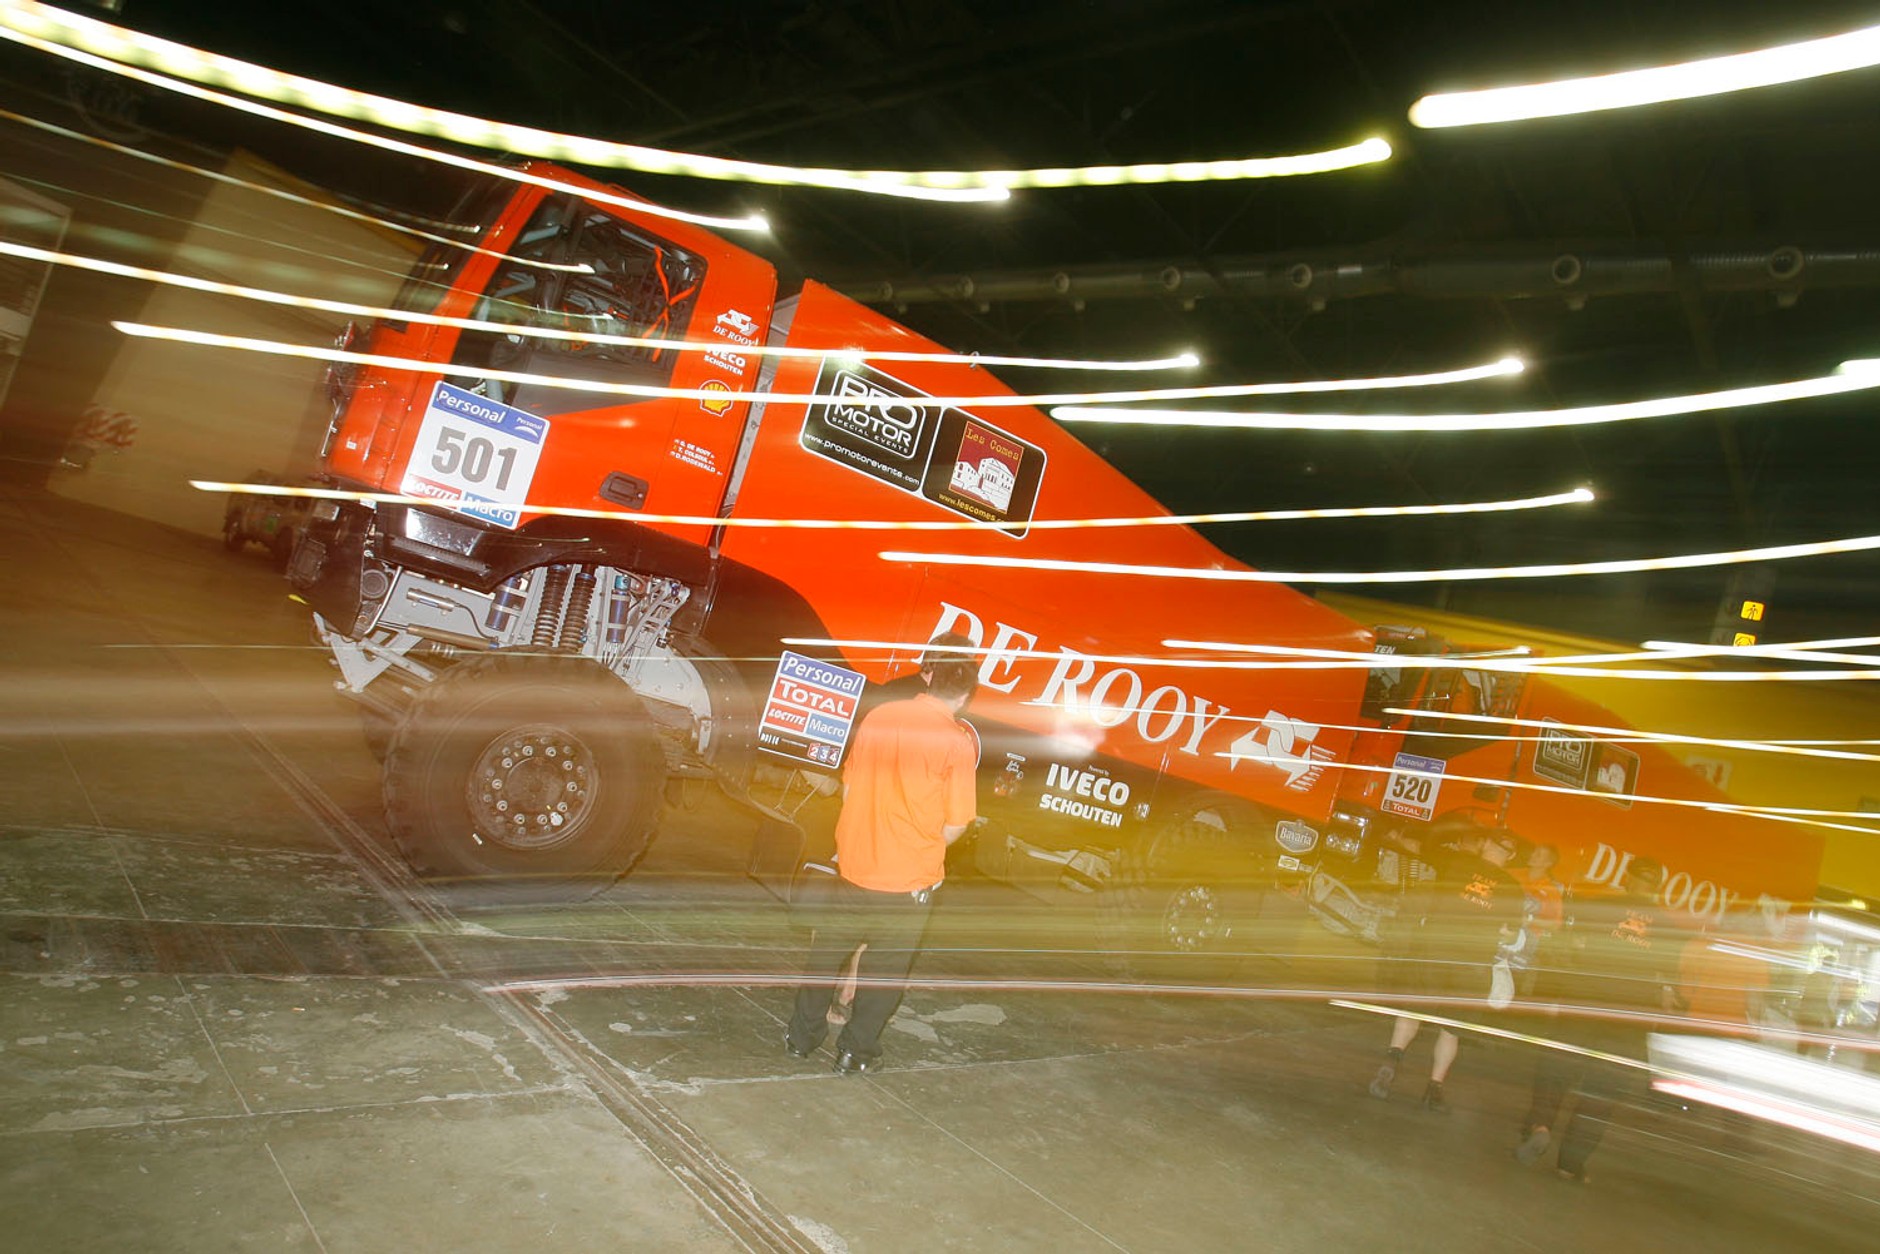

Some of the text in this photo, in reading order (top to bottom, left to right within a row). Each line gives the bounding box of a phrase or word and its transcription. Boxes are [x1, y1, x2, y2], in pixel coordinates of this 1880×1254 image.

[713, 325, 756, 347] DE ROOY
[703, 355, 744, 376] SCHOUTEN
[706, 346, 746, 368] VECO
[436, 389, 543, 430] Personal Personal
[840, 376, 918, 430] PRO
[832, 417, 909, 454] SPECIAL EVENTS
[834, 402, 913, 448] MOTOR
[431, 426, 518, 491] 501
[804, 433, 920, 486] www.promotorevents.com
[966, 428, 1020, 461] Les Comes
[408, 479, 513, 522] OCTITE Macro
[939, 493, 1007, 523] www.lescomes.c
[783, 656, 862, 692] Personal
[911, 601, 1231, 757] DE ROOY
[779, 678, 850, 717] TOTAL
[768, 708, 845, 738] LOCTITE Macro
[1396, 756, 1427, 768] Personal
[1547, 745, 1582, 766] MOTOR
[1045, 763, 1130, 806] IVECO
[1392, 773, 1432, 803] 520
[1040, 793, 1123, 827] SCHOUTEN
[1393, 803, 1421, 816] TOTAL
[1280, 826, 1312, 847] Bavaria
[1660, 865, 1739, 925] OOY
